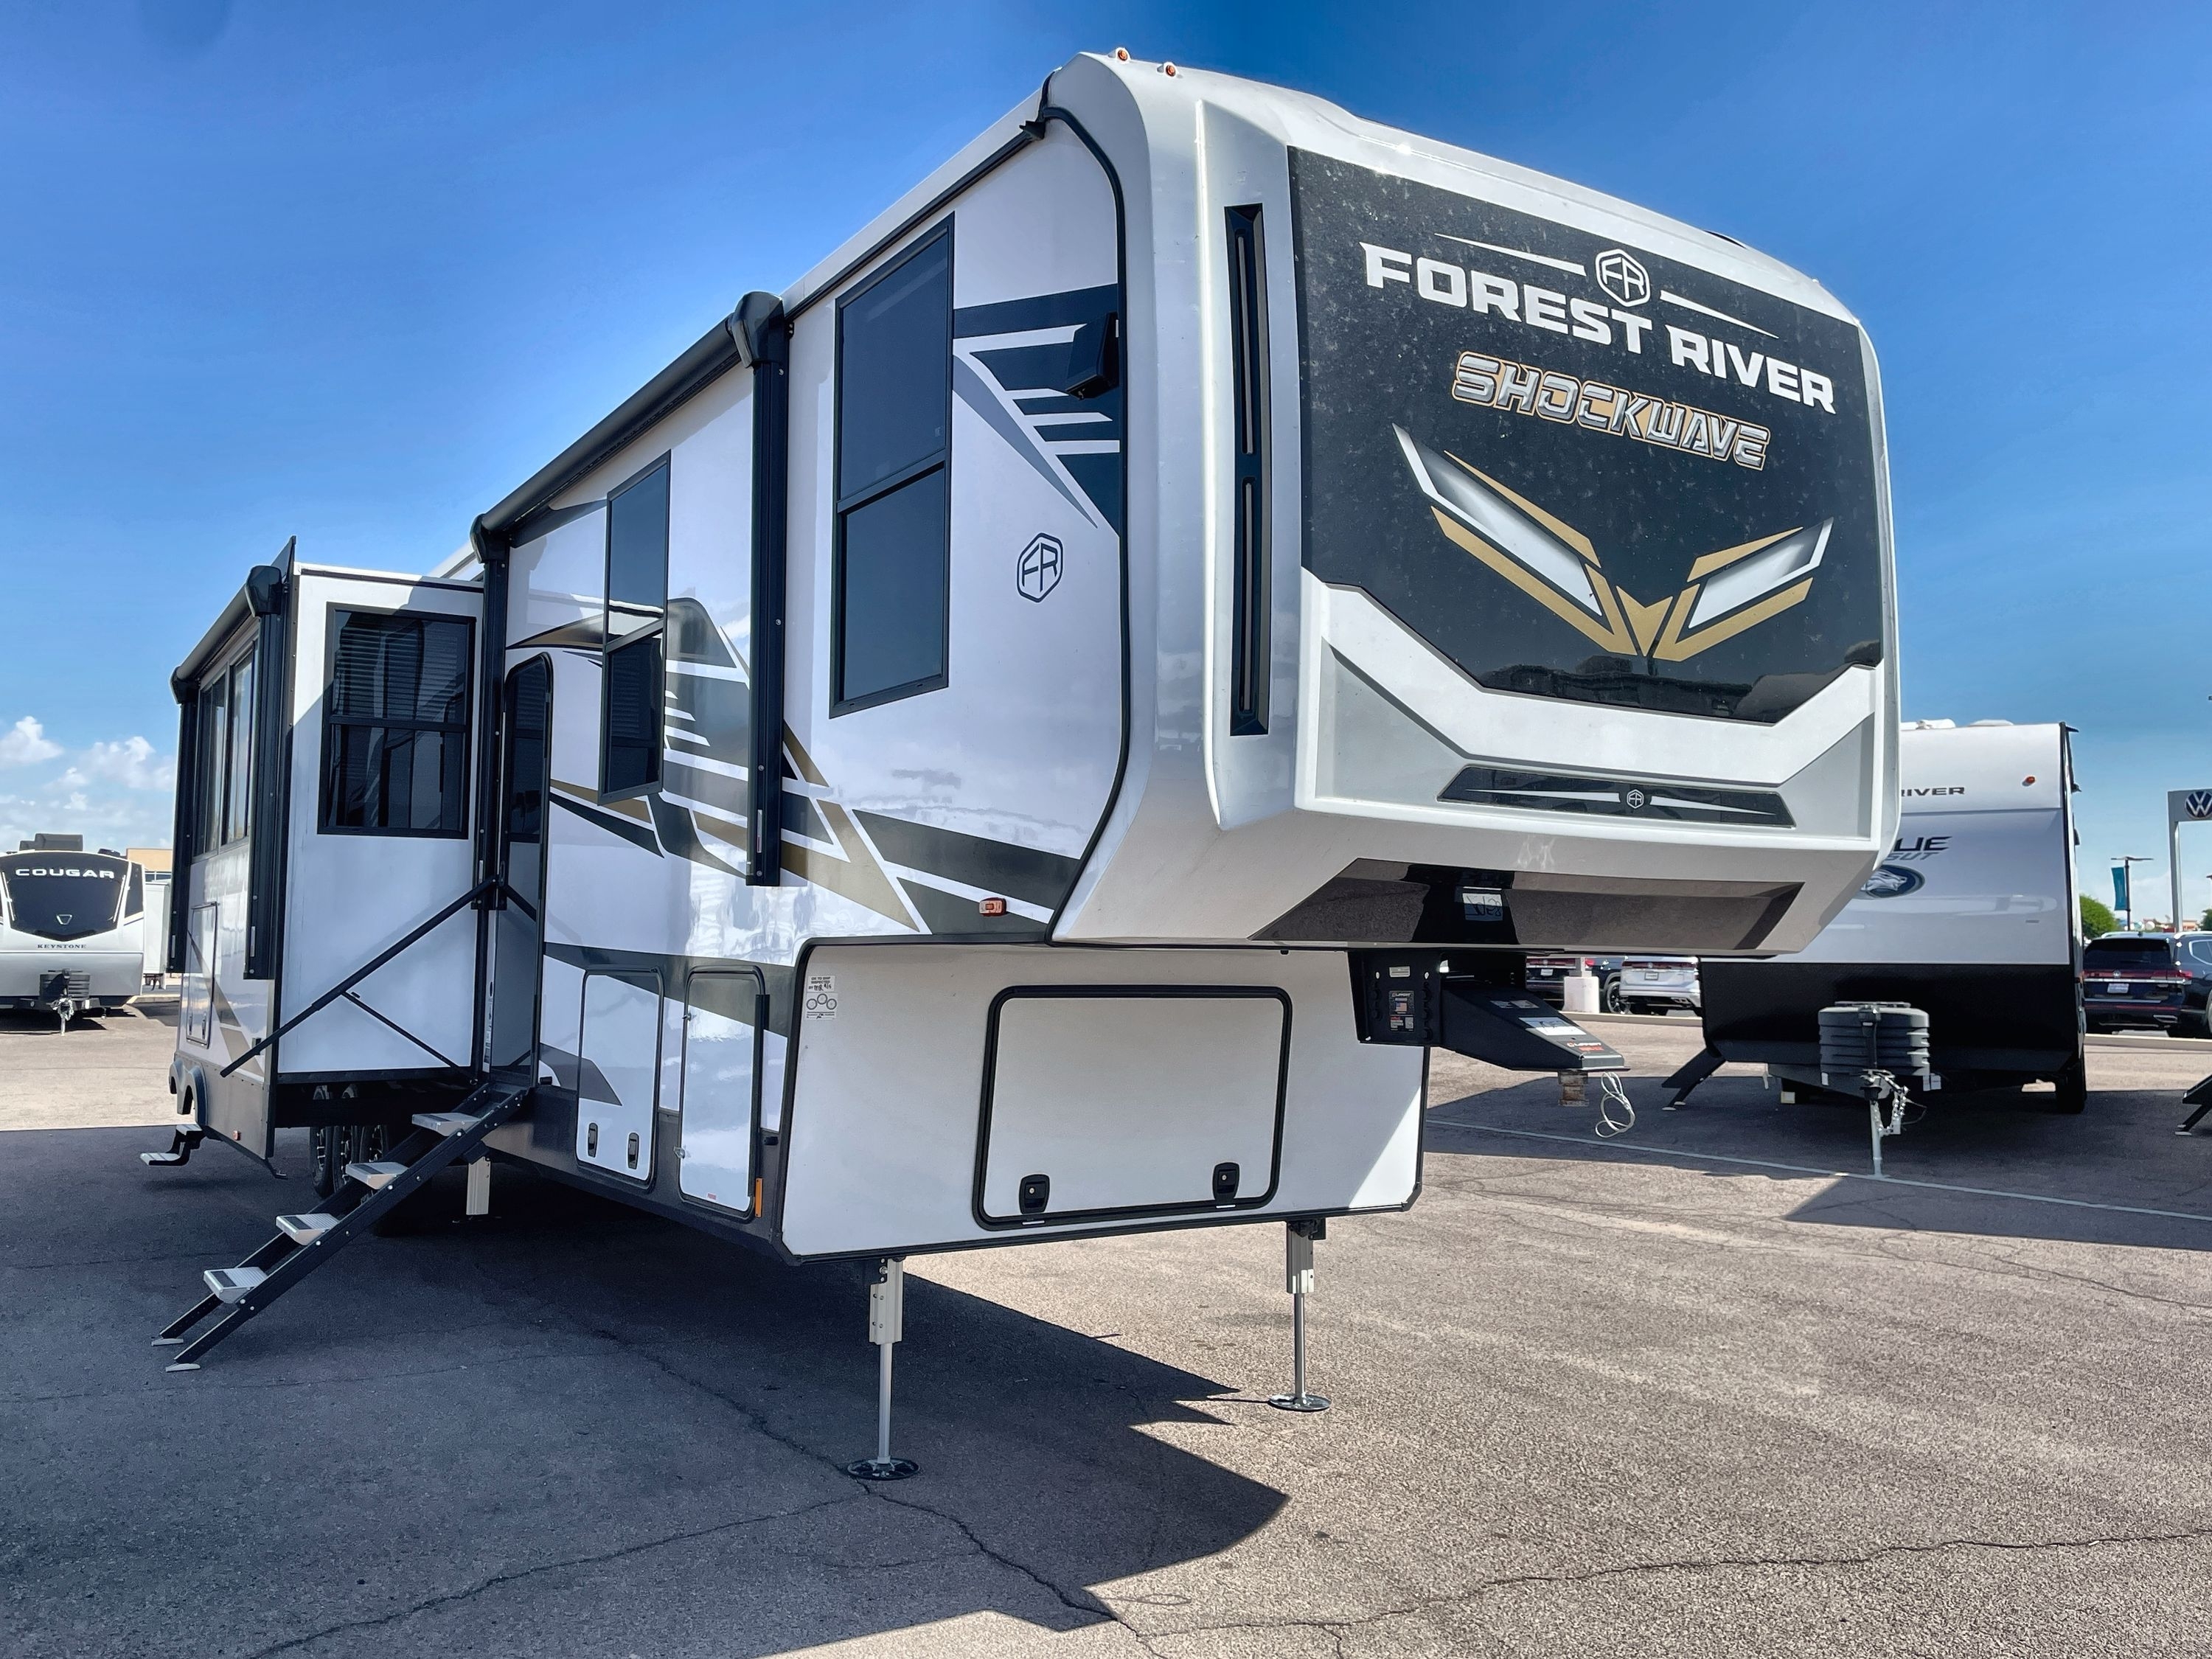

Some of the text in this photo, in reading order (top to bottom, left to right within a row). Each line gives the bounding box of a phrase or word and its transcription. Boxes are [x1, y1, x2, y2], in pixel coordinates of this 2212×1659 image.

[1359, 242, 1837, 414] FOREST RIVER
[1452, 351, 1770, 470] SHOCKWAVE
[15, 869, 114, 879] COUGAR
[1893, 836, 1952, 852] UE
